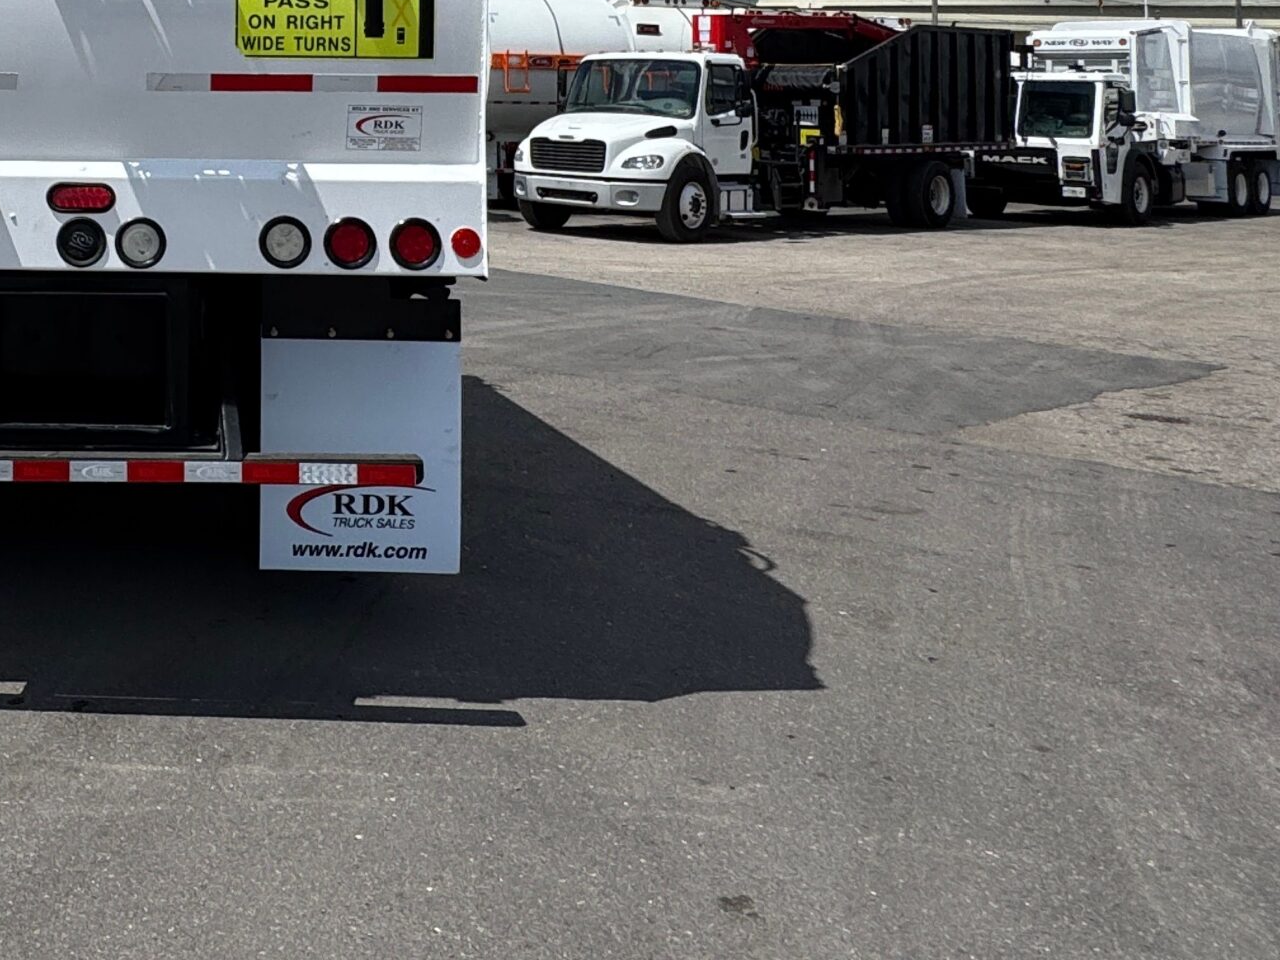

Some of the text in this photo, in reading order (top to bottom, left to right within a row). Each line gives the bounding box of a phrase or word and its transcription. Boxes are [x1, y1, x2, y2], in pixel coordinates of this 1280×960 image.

[248, 14, 345, 30] ON RIGHT
[241, 36, 351, 52] WIDE TURNS
[373, 120, 405, 130] RDK
[982, 154, 1048, 165] MACK
[332, 493, 414, 517] RDK
[332, 517, 415, 529] TRUCK SALES
[292, 541, 428, 559] www.rdk.com
